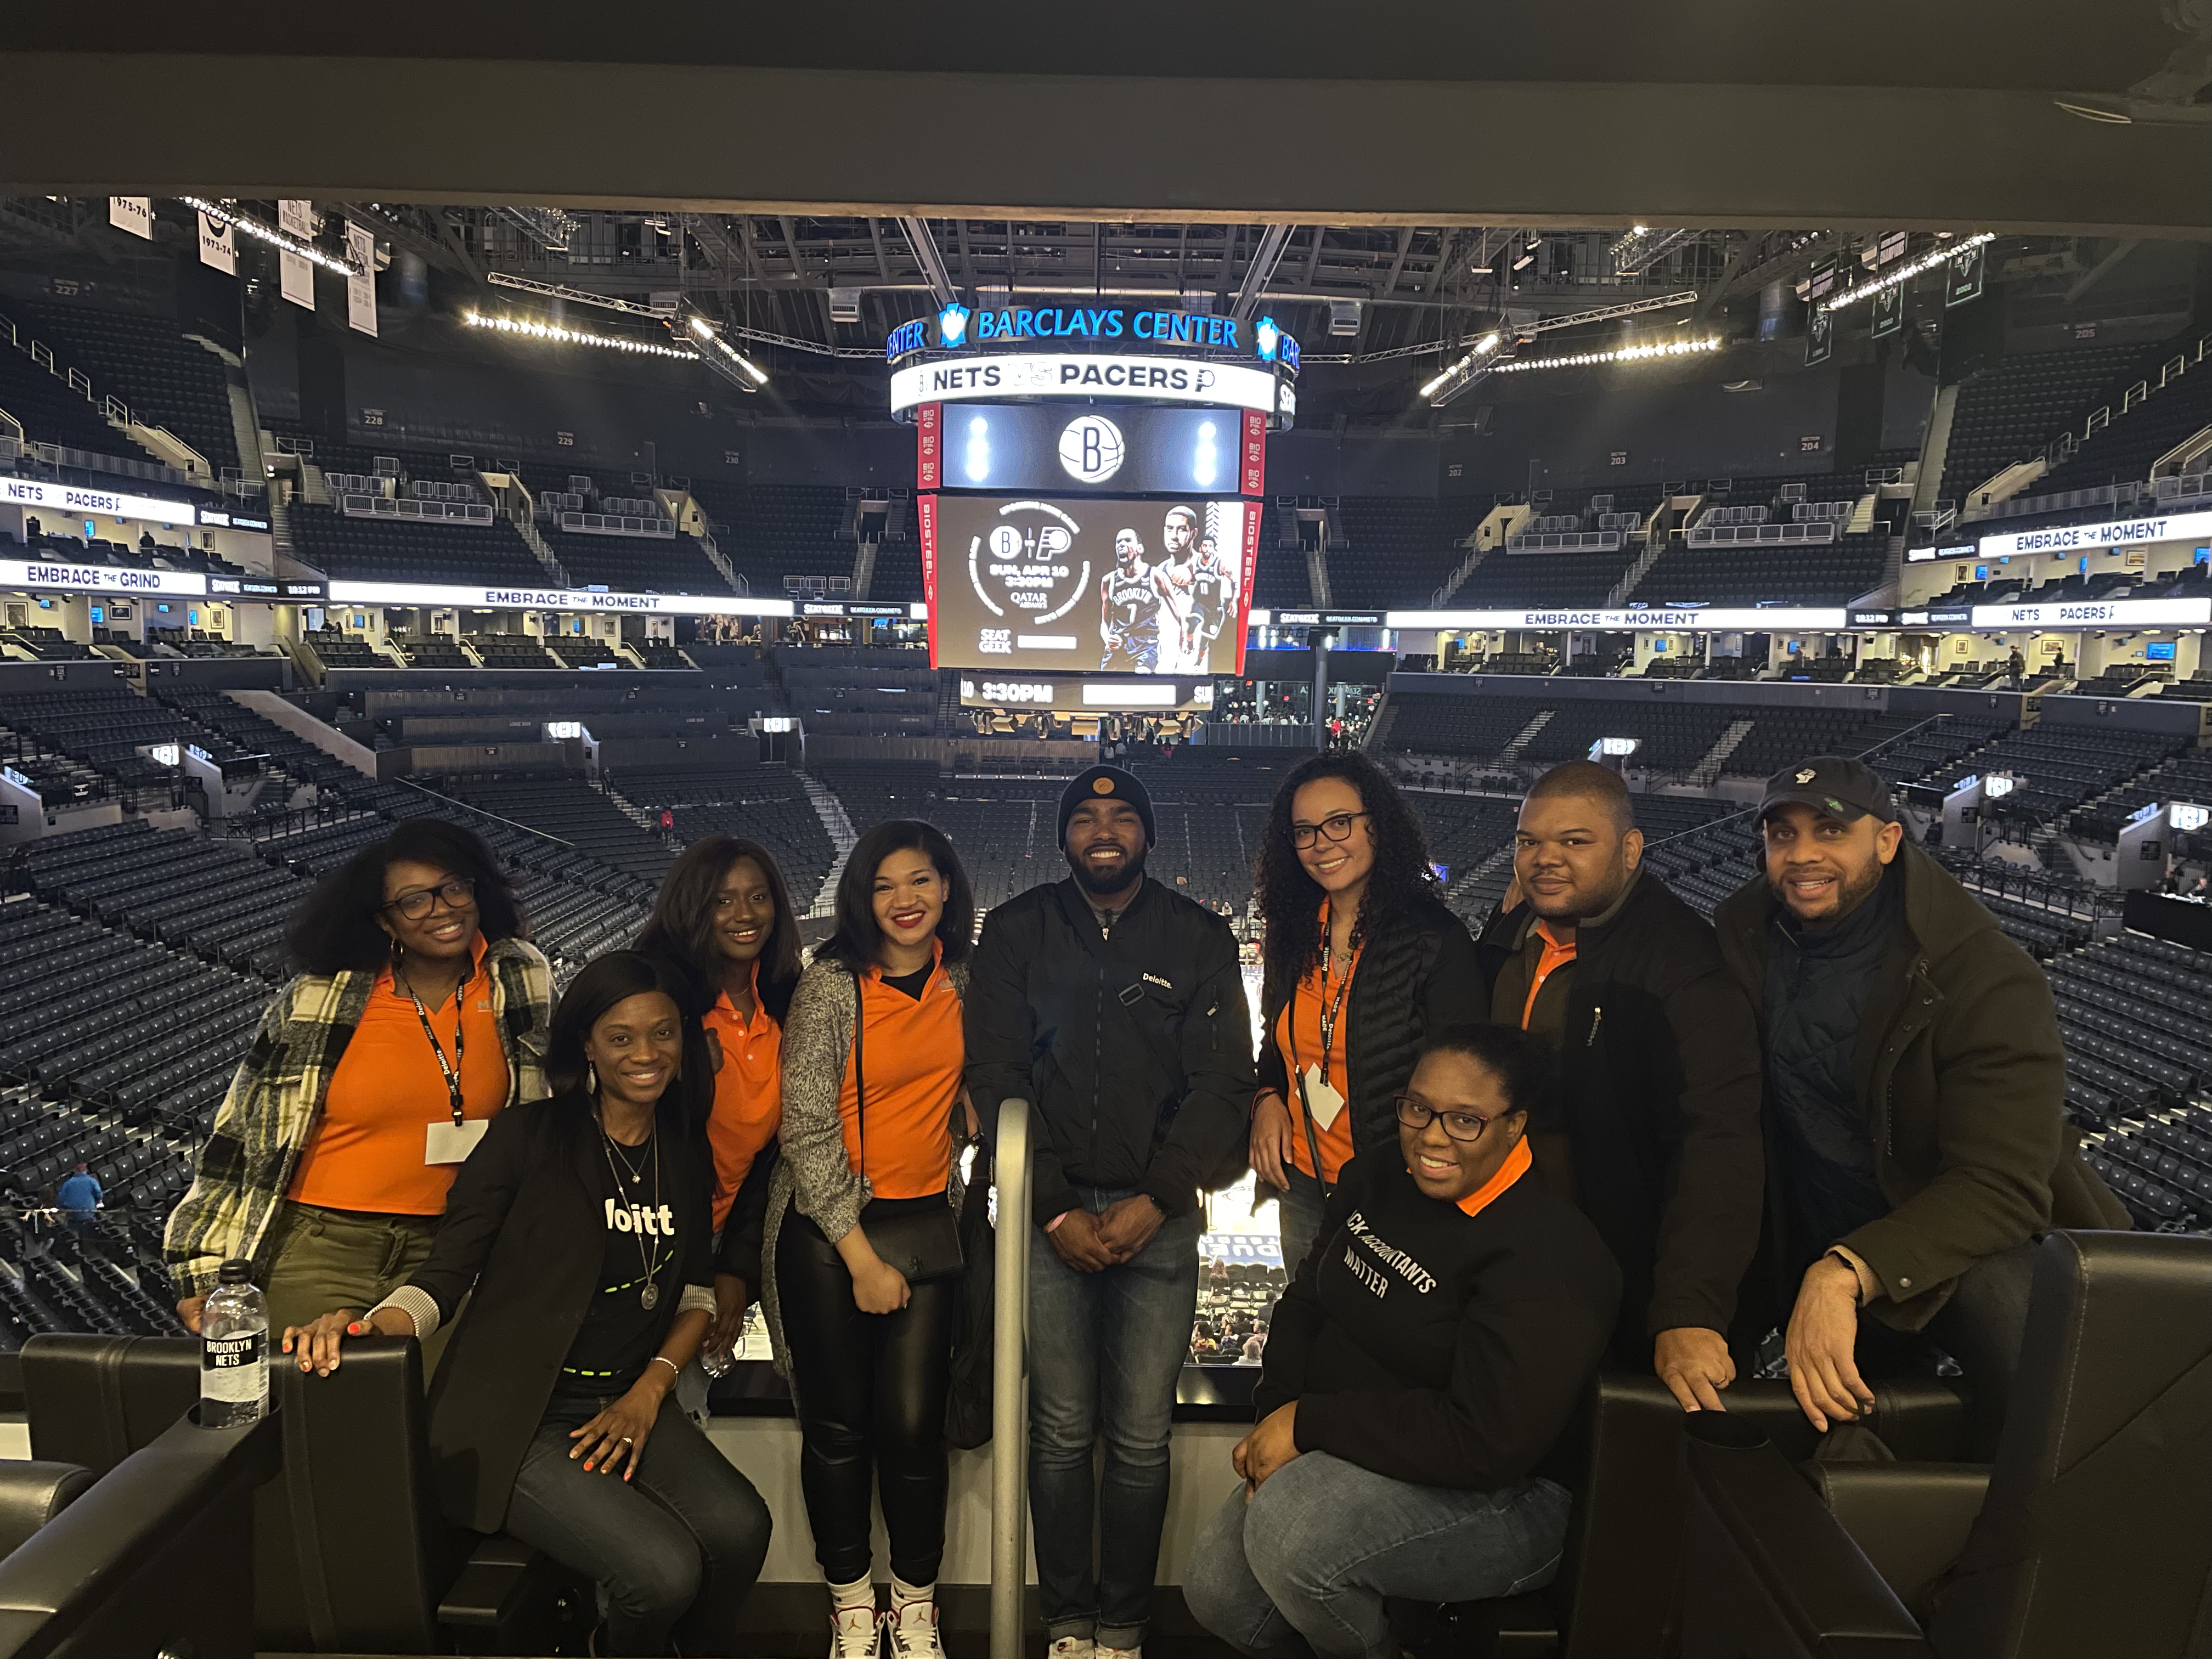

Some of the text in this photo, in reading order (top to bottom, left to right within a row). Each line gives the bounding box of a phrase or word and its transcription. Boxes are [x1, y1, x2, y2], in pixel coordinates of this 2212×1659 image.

[113, 197, 147, 218] 1975-76
[202, 235, 232, 257] 1973-74
[55, 285, 79, 296] 227
[978, 308, 1240, 349] BARCLAYS CENTER
[2075, 329, 2095, 339] 205
[1282, 335, 1301, 370] BAR
[933, 364, 1001, 391] NETS
[1060, 363, 1189, 390] PACERS
[365, 416, 382, 425] 228
[1250, 416, 1261, 424] BIO
[557, 437, 573, 445] 229
[923, 436, 934, 444] BIO
[1249, 442, 1261, 450] BIO
[1802, 442, 1819, 450] 204
[726, 456, 738, 464] 230
[1611, 457, 1626, 465] 203
[1248, 469, 1260, 477] BIO
[8, 483, 43, 500] NETS
[66, 491, 112, 510] PACERS
[923, 504, 933, 580] BIOSTEEL
[2017, 521, 2167, 551] EMBRACE THE MOMENT
[1243, 511, 1256, 587] BIOSTEEL
[27, 565, 160, 588] EMBRACE THE GRIND
[1022, 565, 1050, 577] APR
[1051, 566, 1070, 578] 10
[1005, 576, 1054, 588] 3:30PM
[1199, 582, 1209, 595] 11
[485, 591, 568, 606] EMBRACE
[591, 595, 660, 609] MOMENT
[1010, 592, 1048, 605] QATAR
[1113, 587, 1154, 606] BROOKLYN
[804, 603, 844, 615] SEATGEEK
[1127, 603, 1137, 624] 7
[2012, 609, 2040, 621] NETS
[2060, 606, 2106, 620] PACERS
[1280, 613, 1319, 624] SEATGEEK
[1525, 613, 1600, 625] EMBRACE
[1624, 613, 1699, 625] MOMENT
[980, 629, 1012, 641] SEAT
[979, 640, 1012, 654] GEEK
[982, 682, 1053, 703] 3:30PM
[1332, 996, 1340, 1012] MADE
[424, 1025, 435, 1040] MADE
[605, 1198, 675, 1235] loitt
[1346, 1209, 1369, 1235] CK
[1344, 1245, 1389, 1299] MATTER
[206, 1339, 252, 1354] BROOKLYN
[216, 1354, 240, 1367] NETS
